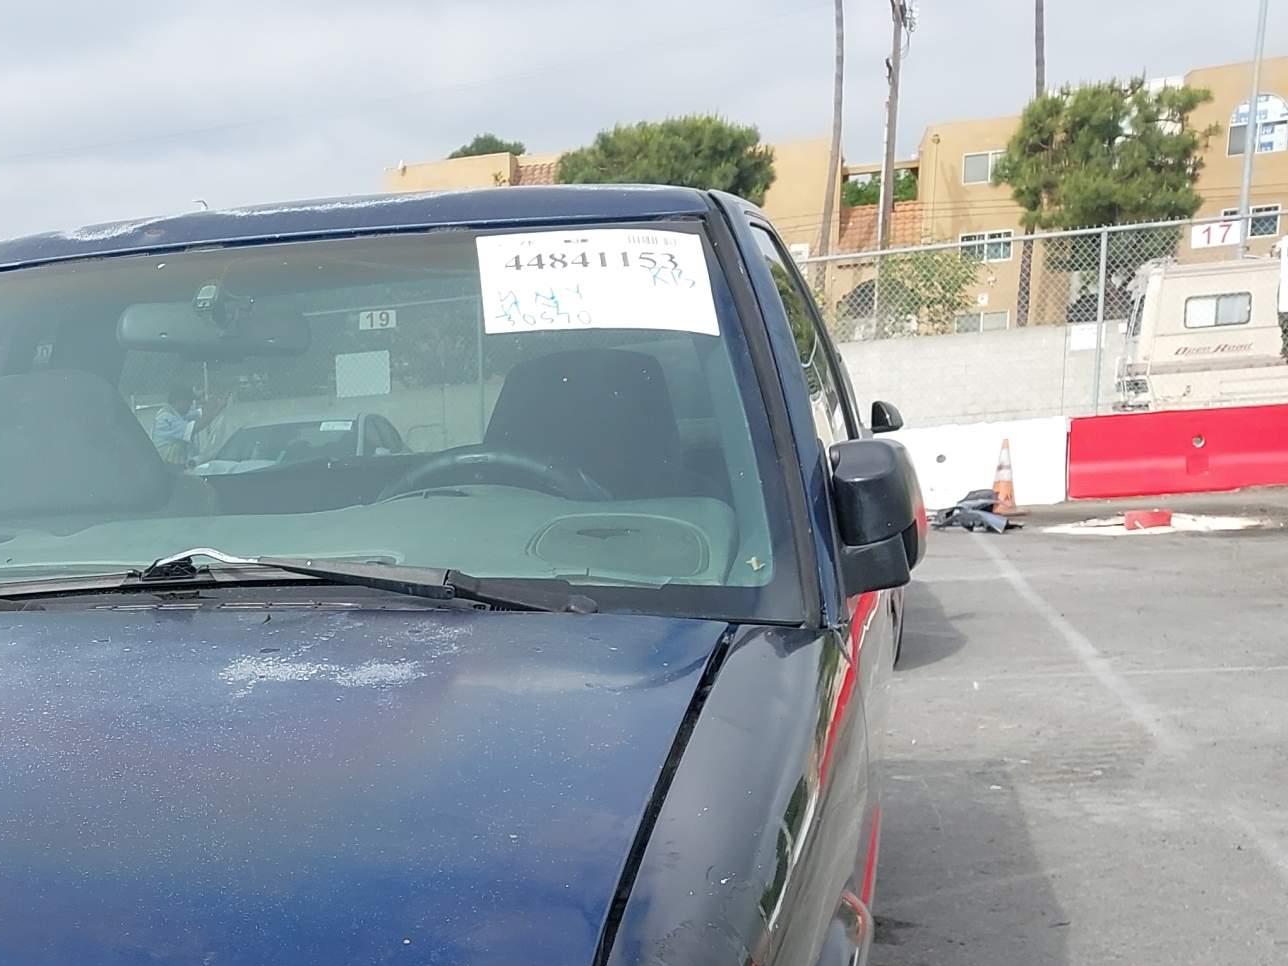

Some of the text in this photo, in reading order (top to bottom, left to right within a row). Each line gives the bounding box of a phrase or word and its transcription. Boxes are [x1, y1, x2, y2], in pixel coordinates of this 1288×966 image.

[1202, 224, 1232, 245] 17
[505, 251, 679, 271] 44841153
[366, 311, 390, 329] 19
